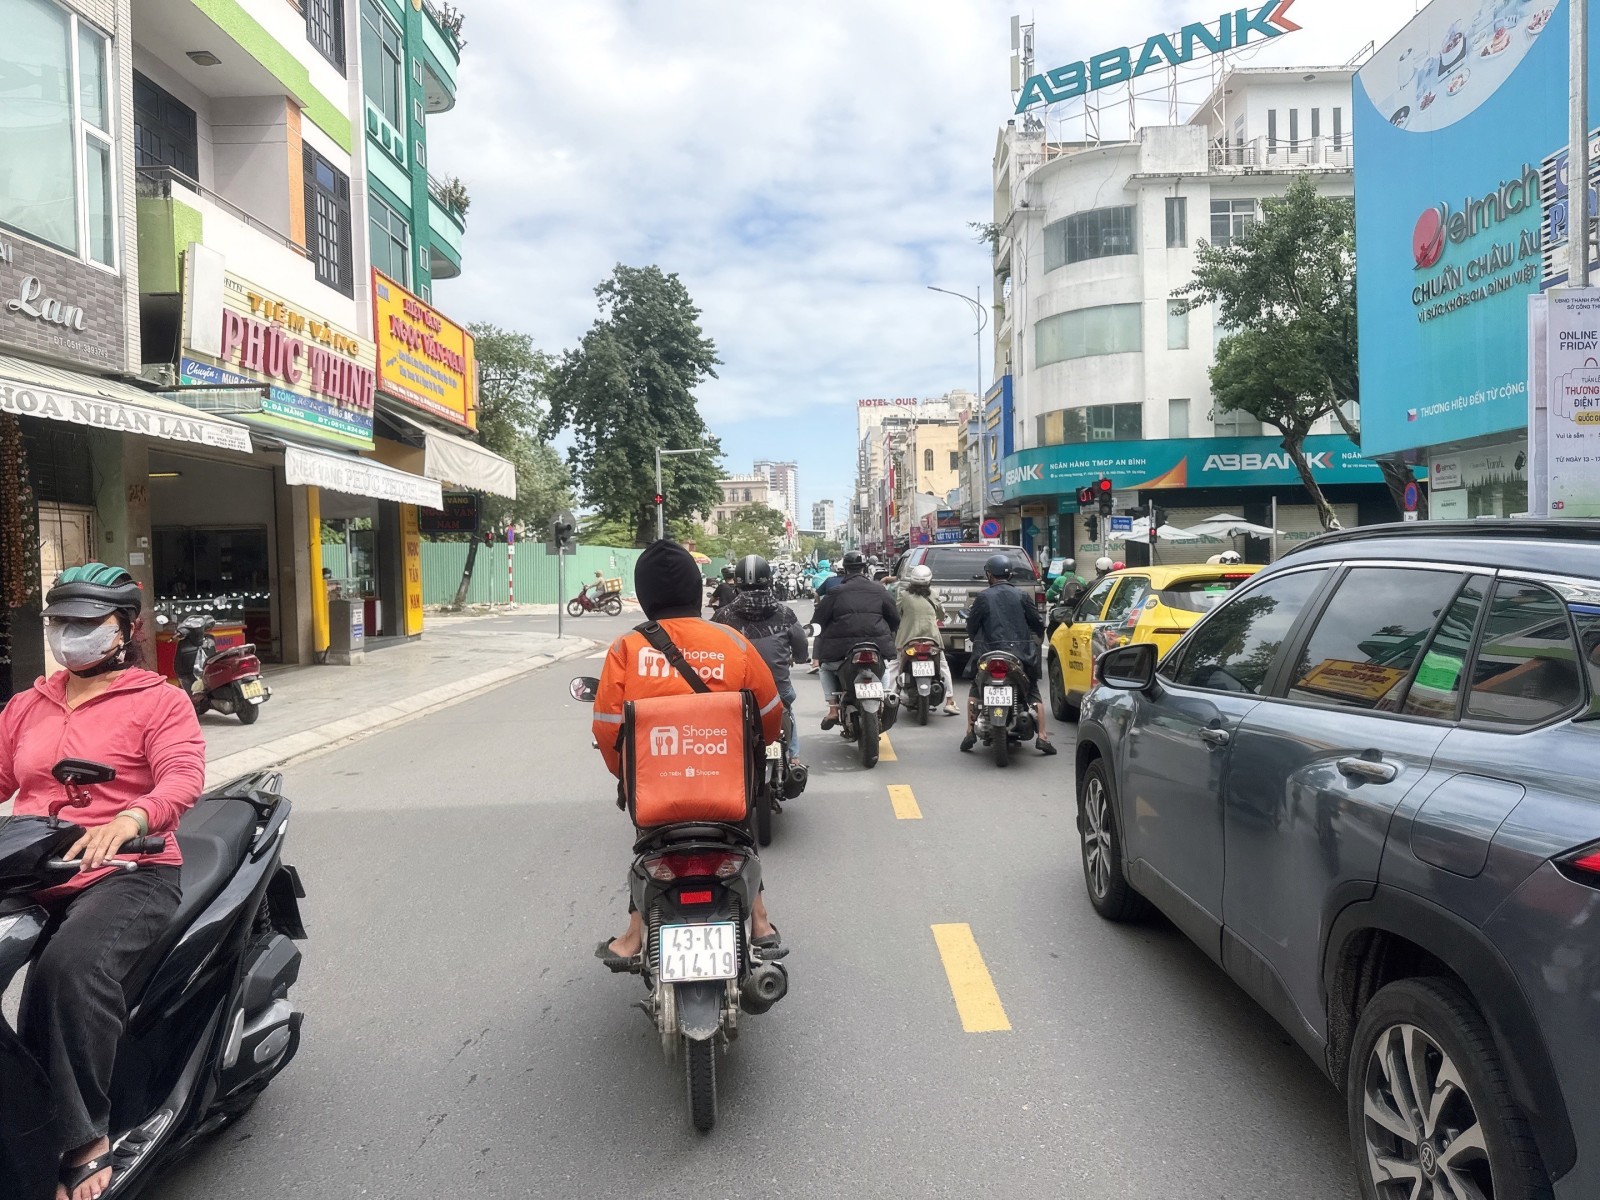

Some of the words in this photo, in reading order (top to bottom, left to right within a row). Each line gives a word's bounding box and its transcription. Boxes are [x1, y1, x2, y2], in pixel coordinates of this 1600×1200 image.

[224, 278, 243, 293] NTN
[6, 276, 87, 331] Lan
[1559, 331, 1598, 340] ONLINE
[1560, 341, 1598, 350] FRIDAY
[221, 308, 304, 385] PHÚC
[158, 417, 204, 441] LAN
[682, 725, 728, 740] Shopee
[682, 738, 728, 755] Food
[672, 927, 722, 951] 43-K1
[665, 951, 733, 978] 414.19
